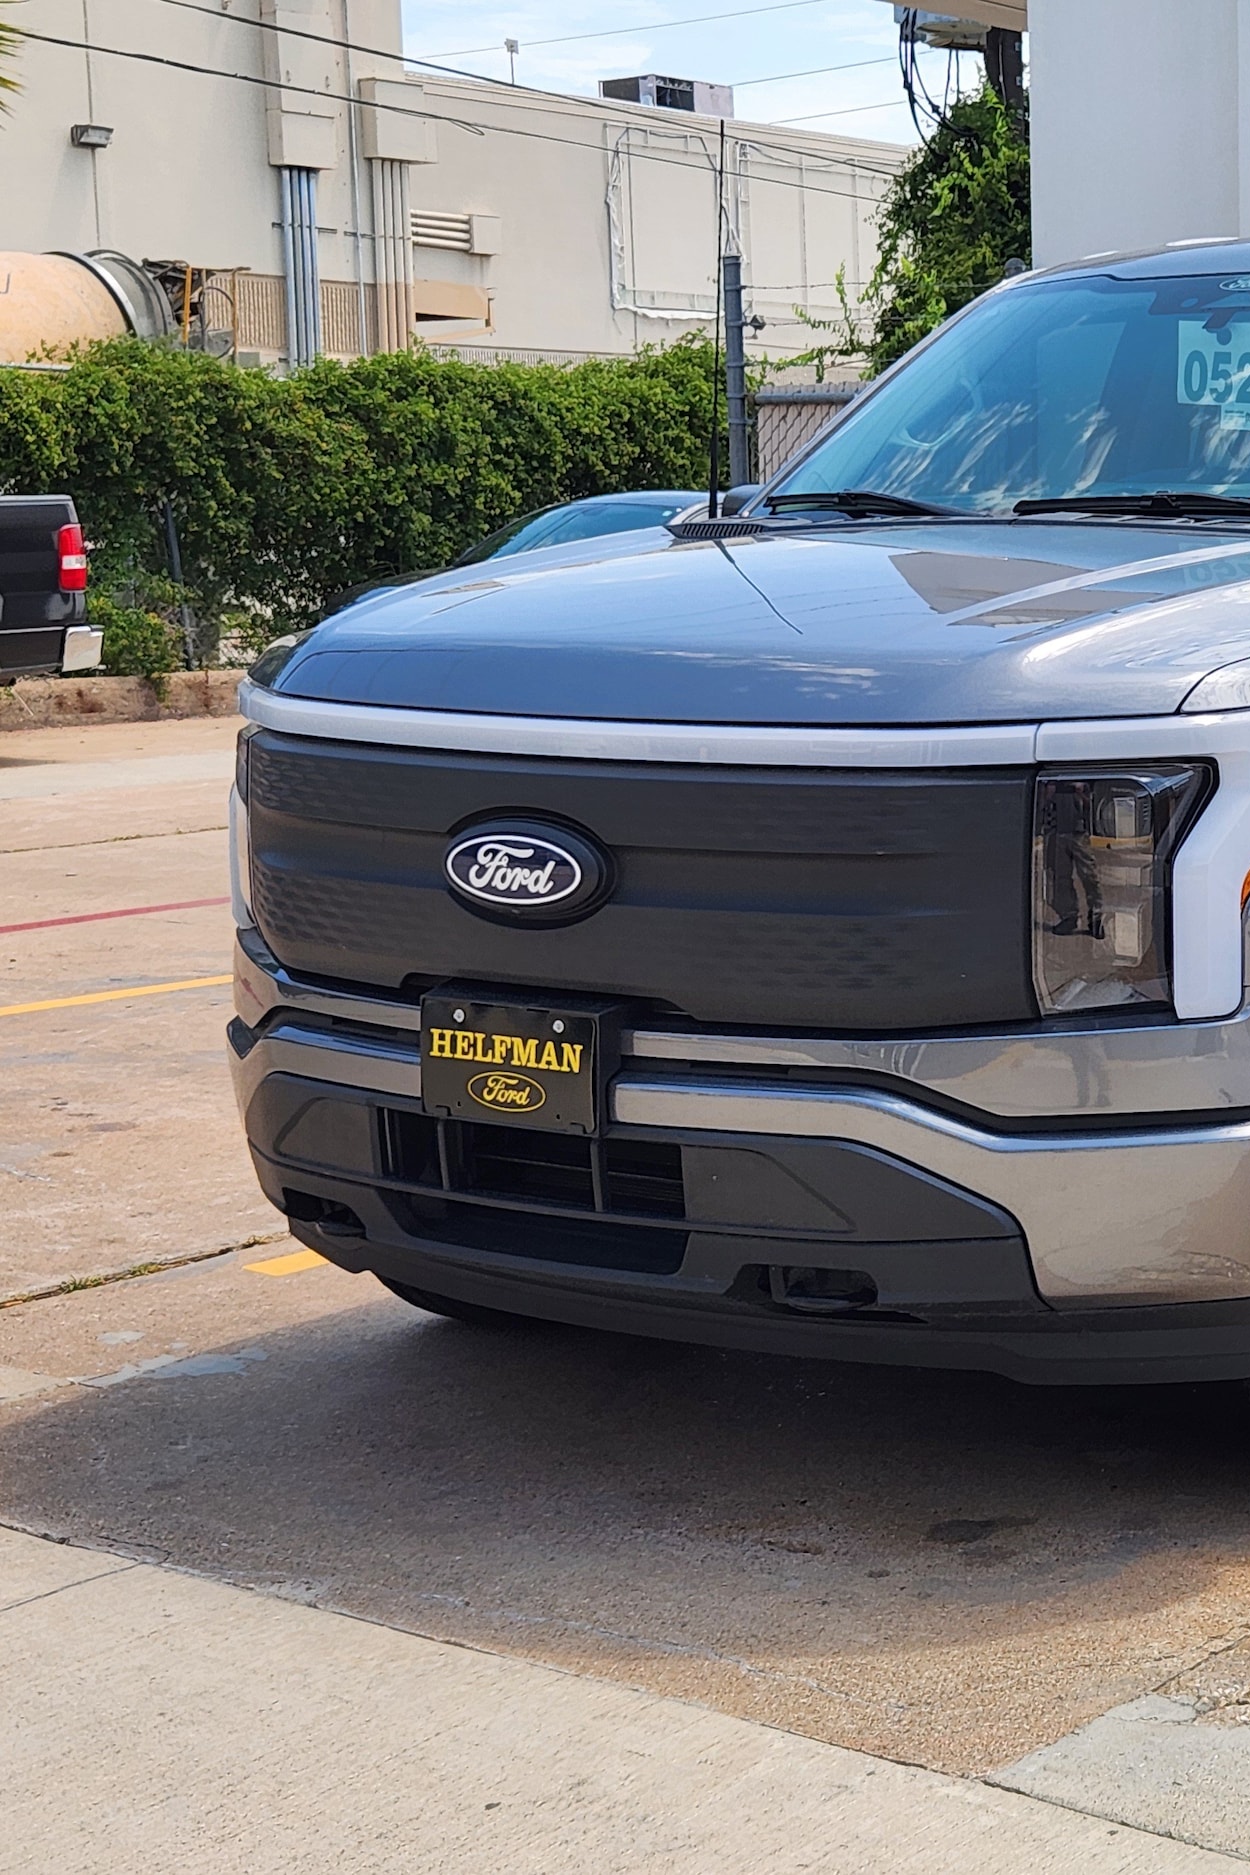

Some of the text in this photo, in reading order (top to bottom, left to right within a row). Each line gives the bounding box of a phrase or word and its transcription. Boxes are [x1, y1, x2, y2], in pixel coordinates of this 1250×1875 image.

[469, 843, 556, 895] Ford
[430, 1028, 583, 1073] HELFMAN
[483, 1075, 531, 1106] Ford
